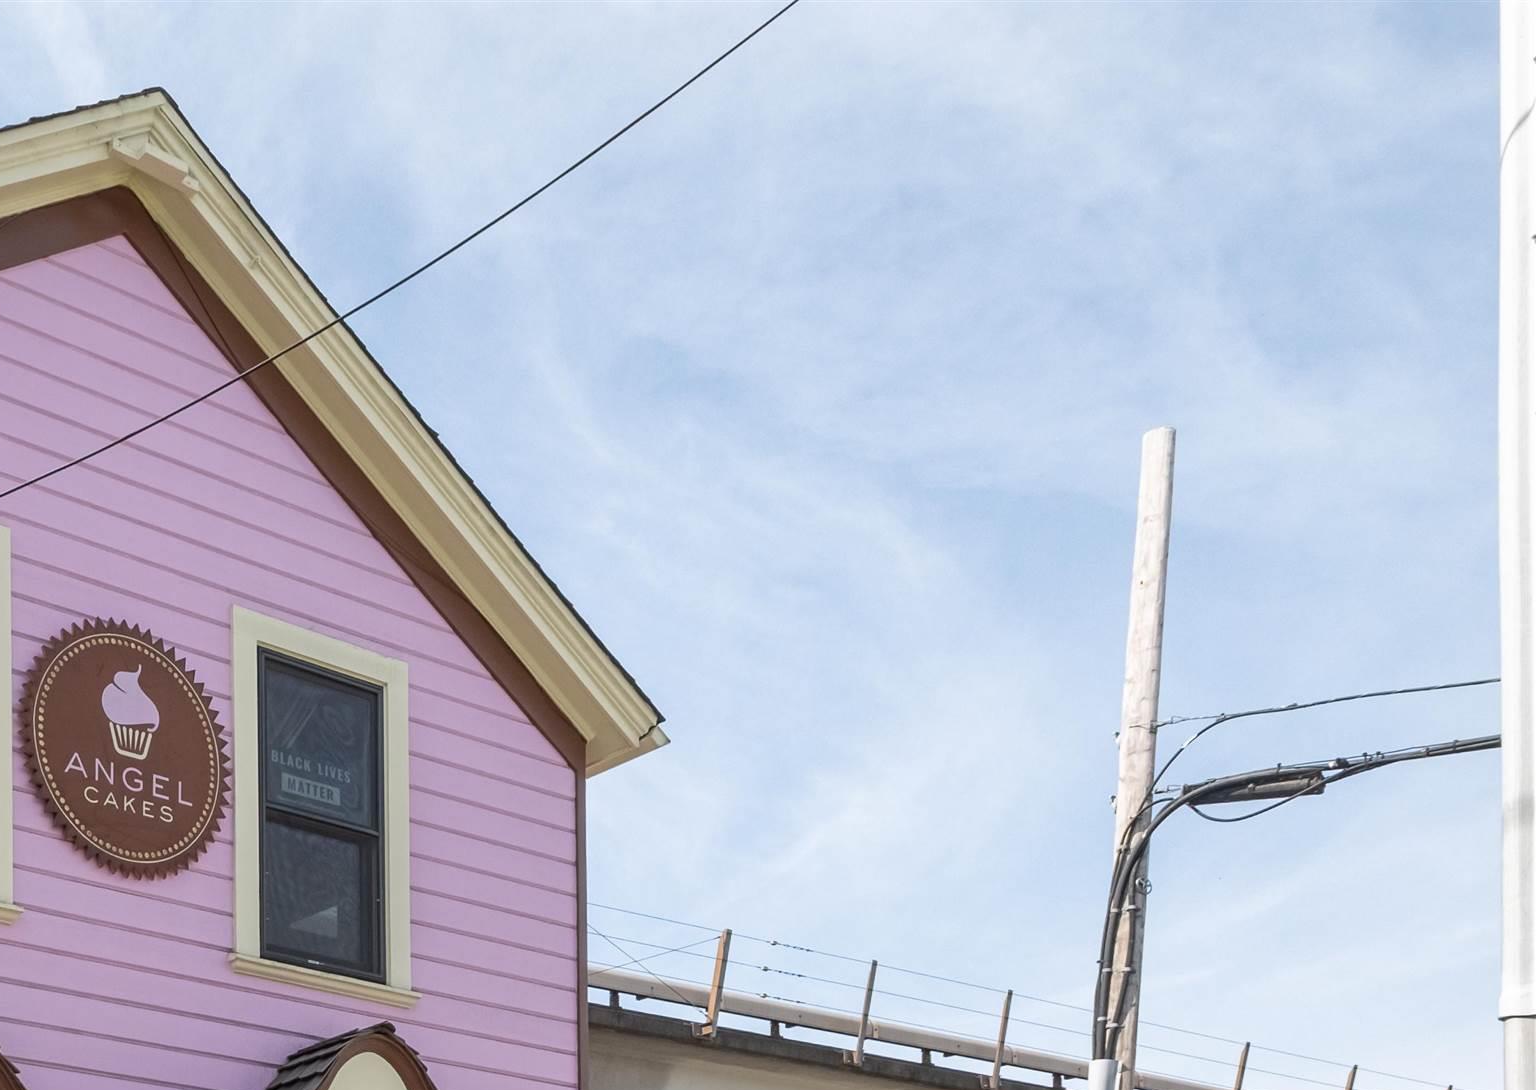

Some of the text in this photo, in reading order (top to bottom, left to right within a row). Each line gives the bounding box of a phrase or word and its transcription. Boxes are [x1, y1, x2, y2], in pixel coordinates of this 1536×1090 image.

[64, 752, 193, 807] ANGEL
[271, 749, 351, 784] BLACK LIVES
[84, 786, 174, 823] CAKES
[287, 775, 334, 801] MATTER
